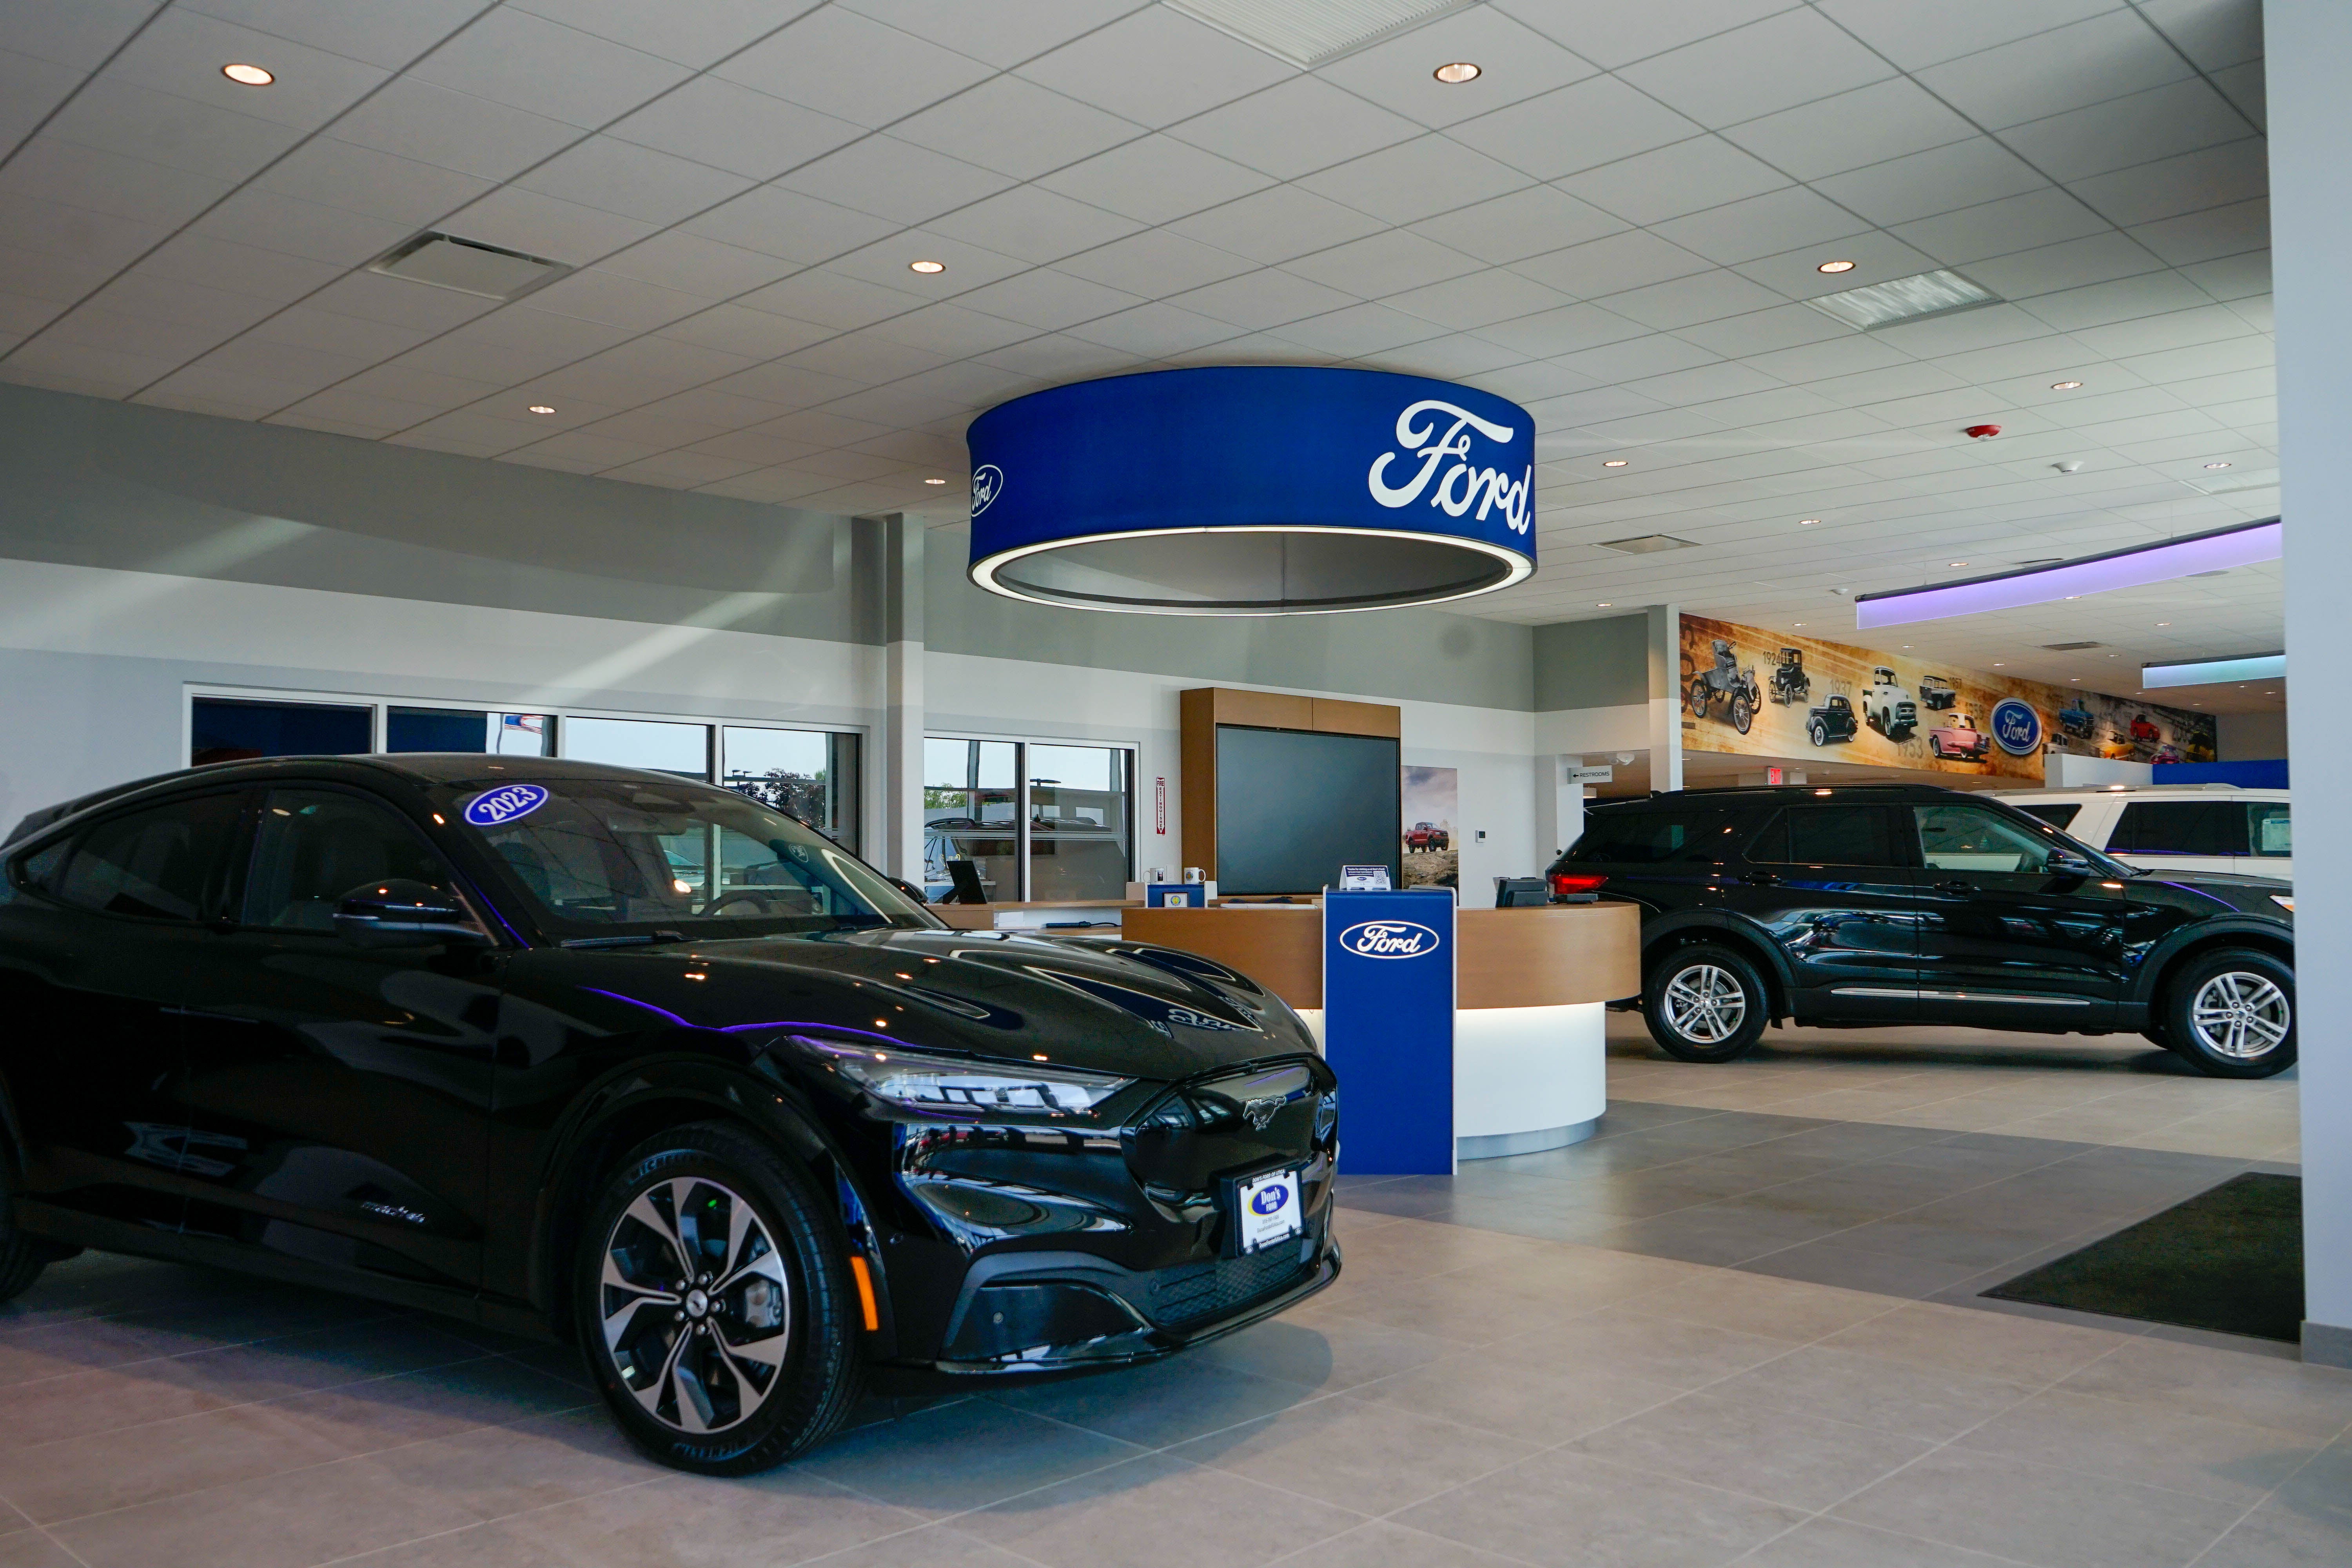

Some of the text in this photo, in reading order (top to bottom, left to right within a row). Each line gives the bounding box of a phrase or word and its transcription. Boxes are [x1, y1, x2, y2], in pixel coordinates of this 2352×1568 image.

[1368, 399, 1532, 535] Ford
[972, 472, 993, 511] Ford
[1763, 652, 1781, 666] 1924
[2002, 710, 2031, 742] Ford
[1898, 736, 1924, 759] 1953
[1770, 768, 1781, 784] EXIT
[478, 787, 538, 821] 2023
[1357, 925, 1423, 953] Ford
[1260, 1187, 1281, 1205] Don's
[1266, 1201, 1278, 1212] FORD
